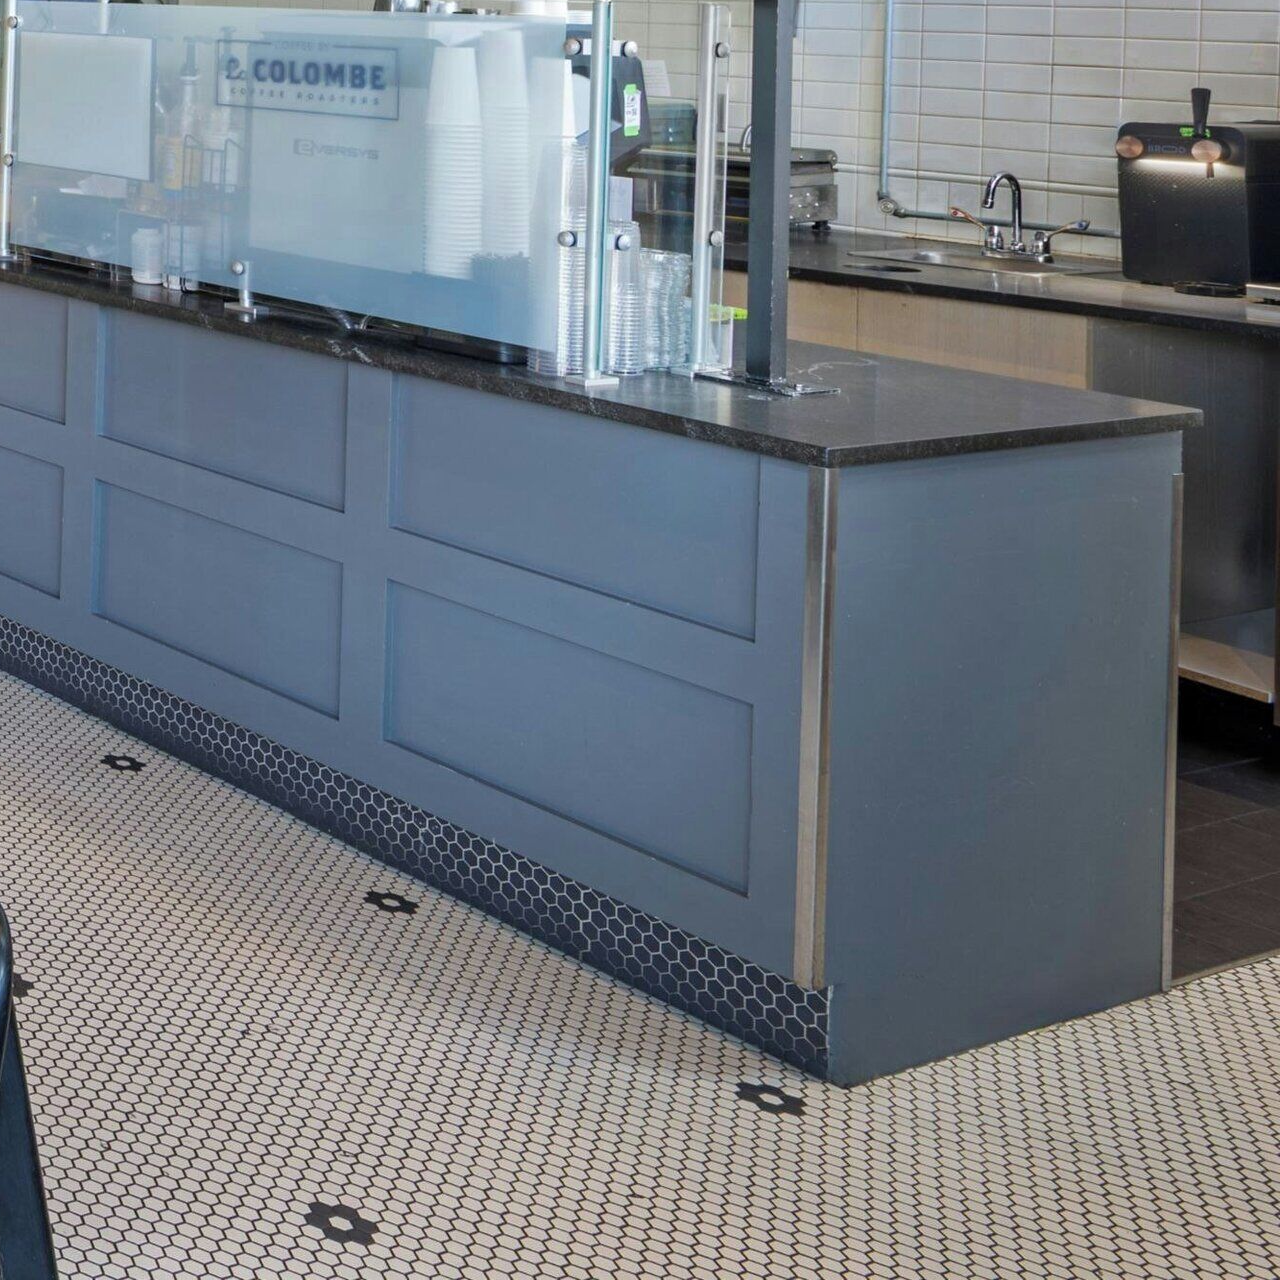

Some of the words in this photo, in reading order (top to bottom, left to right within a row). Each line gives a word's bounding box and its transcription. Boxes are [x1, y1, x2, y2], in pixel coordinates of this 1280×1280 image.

[253, 58, 386, 90] COLOMBE
[230, 87, 285, 99] COFFEE
[297, 91, 380, 106] ROASTERS
